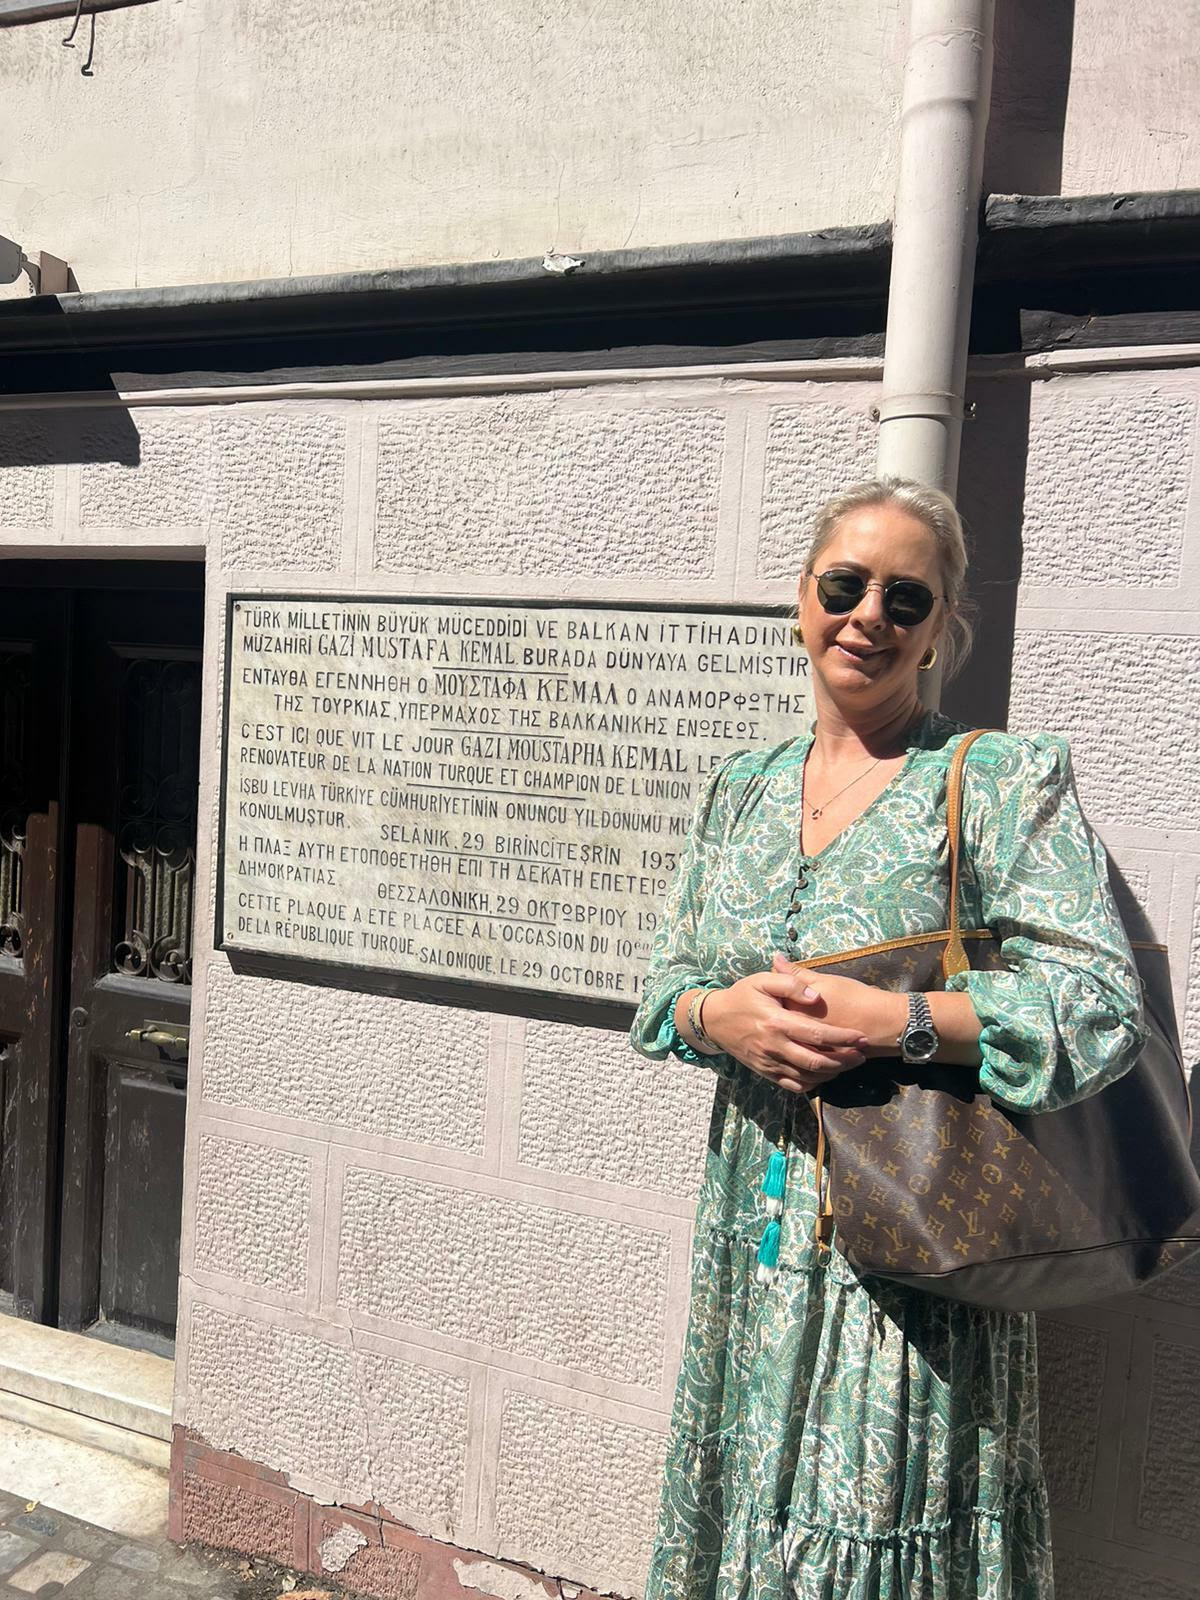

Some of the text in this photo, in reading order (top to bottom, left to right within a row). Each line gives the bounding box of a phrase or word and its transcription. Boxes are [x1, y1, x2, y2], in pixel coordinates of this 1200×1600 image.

[244, 606, 280, 628] TÜRK
[377, 611, 429, 634] BÜYÜK
[438, 612, 527, 638] MÜCEDDİDİ
[537, 621, 558, 639] VE
[568, 621, 648, 642] BALKAN
[659, 619, 794, 647] İTTİHADINI
[362, 636, 450, 662] MUSTAFA
[523, 648, 597, 668] BURADA
[607, 648, 687, 672] DÜNYAYA
[243, 668, 308, 687] ΕΝΤΑΥΘΑ
[316, 671, 410, 693] ΕΓΕΝΝΗΘΗ
[418, 677, 427, 694] Ο
[435, 673, 527, 700] ΜΟΥΣΤΑΦΑ
[537, 678, 618, 705] ΚΕΜΑΛ
[627, 688, 637, 705] Ο
[274, 693, 303, 712] ΤΗΣ
[509, 708, 541, 727] ΤΗΣ
[549, 711, 668, 735] ΒΑΛΚΑΝΙΚΗΣ
[241, 723, 284, 742] C'EST
[292, 727, 309, 744] ICI
[316, 728, 344, 748] QUE
[352, 731, 375, 749] VIT
[383, 733, 404, 752] LE
[412, 736, 454, 755] JOUR
[461, 735, 501, 760] GAZI
[508, 738, 605, 768] MOUSTAPHA
[611, 745, 688, 773] KEMAL
[240, 747, 326, 770] RENOVATEUR
[333, 755, 350, 772] DE
[357, 757, 376, 775] LA
[383, 760, 432, 779] NATION
[439, 764, 493, 784] TURQUE
[500, 769, 518, 786] ET
[524, 771, 599, 792] CHAMPION
[605, 777, 625, 795] DE
[273, 780, 316, 801] LEVHA
[321, 782, 374, 805] TÜRKİYE
[506, 802, 567, 824] ONUNCU
[239, 835, 248, 851] Η
[254, 837, 291, 856] ΠΛΑΞ
[298, 842, 335, 861] ΑΥΤΗ
[340, 847, 451, 874] ΕΤΟΠΟΘΕΤΗΘΗ
[458, 858, 482, 877] ΕΠΙ
[489, 860, 510, 880] ΤΗ
[517, 863, 583, 888] ΔΕΚΑΤΗ
[462, 831, 484, 851] 29
[642, 850, 682, 871] 193
[238, 892, 281, 913] CETTE
[288, 898, 347, 921] PLAQUE
[353, 908, 362, 923] A
[471, 921, 481, 938] A
[591, 936, 609, 954] DU
[497, 895, 519, 915] 29
[638, 912, 657, 931] 19
[238, 916, 253, 933] DE
[256, 918, 270, 934] LA
[500, 958, 517, 976] LE
[522, 960, 543, 979] 29
[550, 965, 625, 992] OCTOBRE
